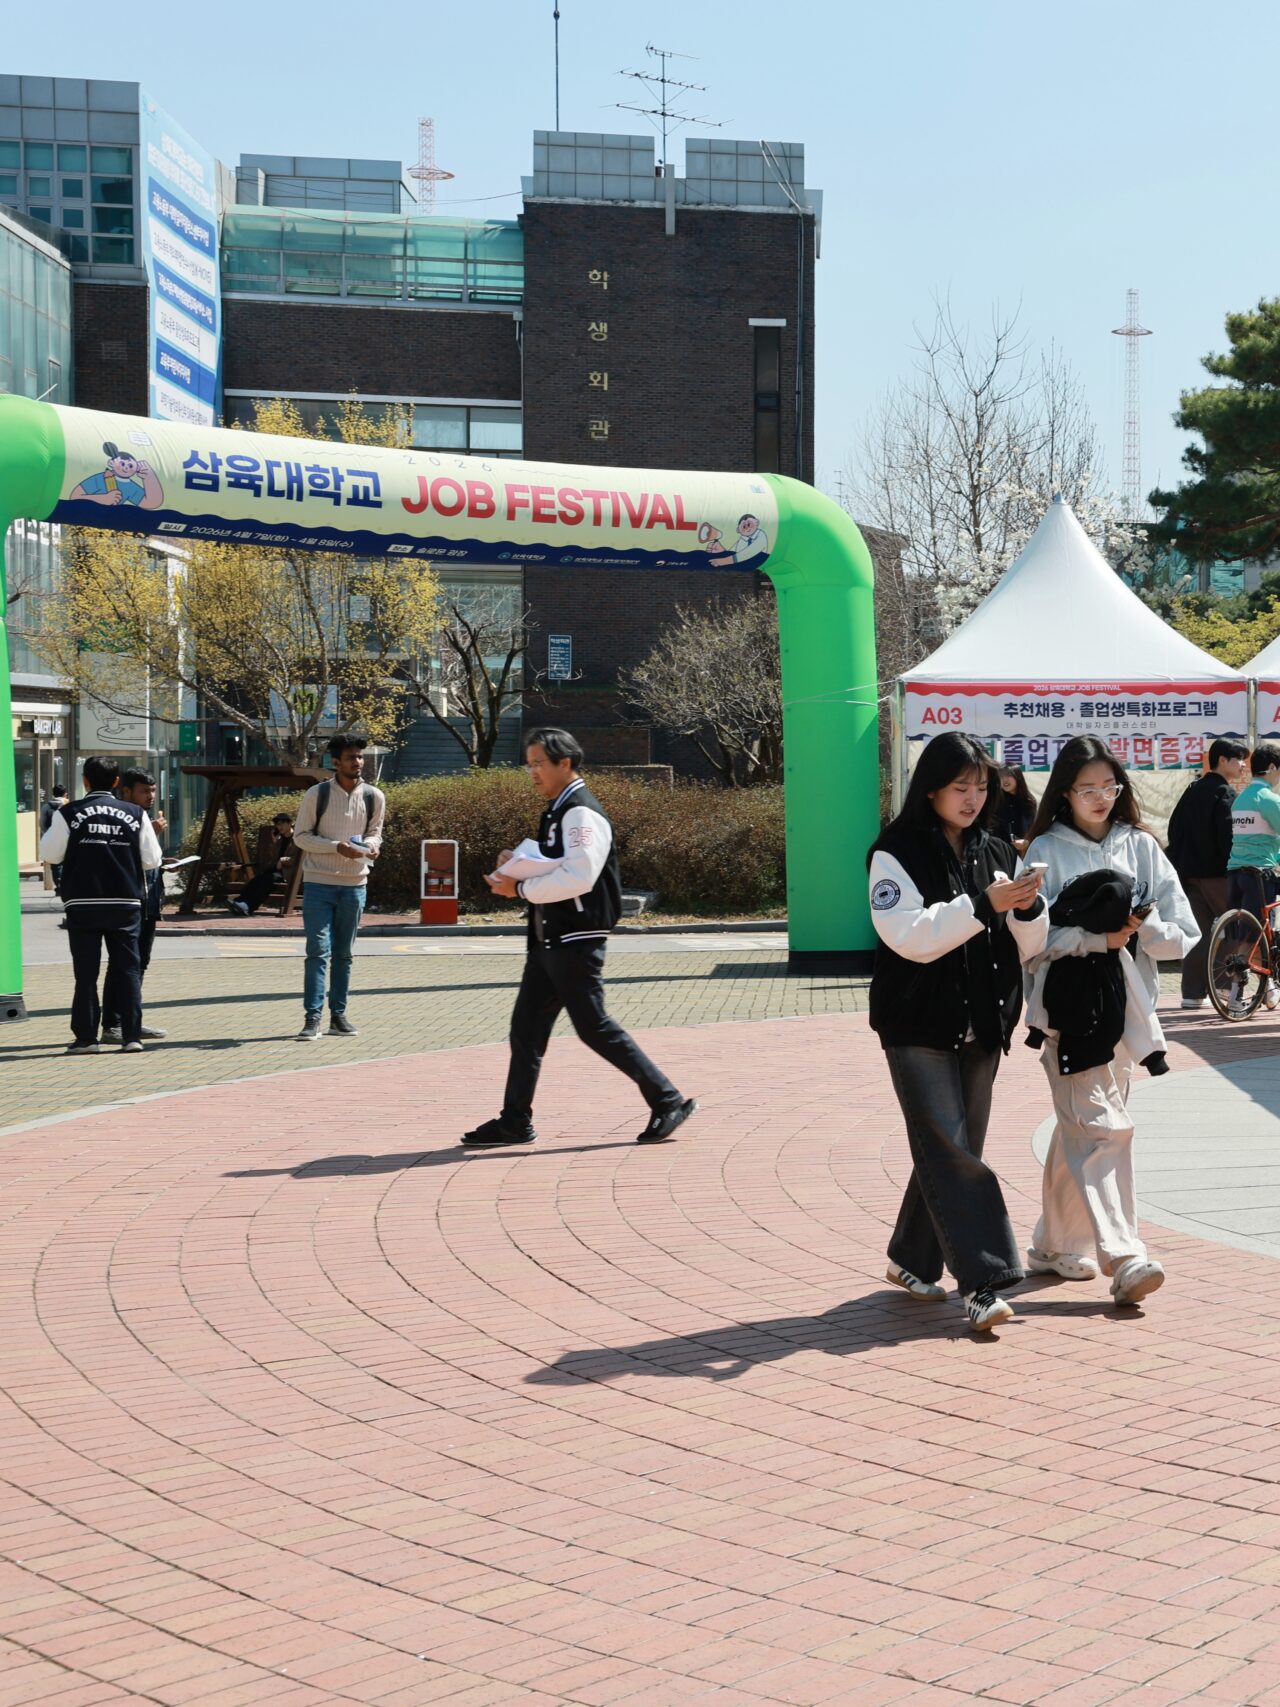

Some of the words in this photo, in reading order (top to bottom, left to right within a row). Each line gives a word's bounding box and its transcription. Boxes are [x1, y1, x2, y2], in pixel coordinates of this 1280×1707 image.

[587, 268, 611, 441] 학생회관
[402, 454, 493, 472] 2026
[182, 449, 383, 509] 삼육대학교
[401, 475, 497, 519] JOB
[504, 483, 698, 531] FESTIVAL
[190, 525, 232, 538] 2026년
[232, 530, 254, 540] 4월
[298, 537, 319, 546] 4월
[1077, 684, 1091, 692] JOB
[1091, 684, 1122, 692] FESTIVAL
[921, 706, 963, 725] A03
[1003, 701, 1066, 718] 추천채용
[1079, 700, 1219, 718] 졸업생특화프로그램
[1159, 736, 1204, 764] 증정
[71, 805, 140, 832] SAHMYOOK
[88, 823, 124, 836] UNIV.
[569, 826, 592, 848] 25
